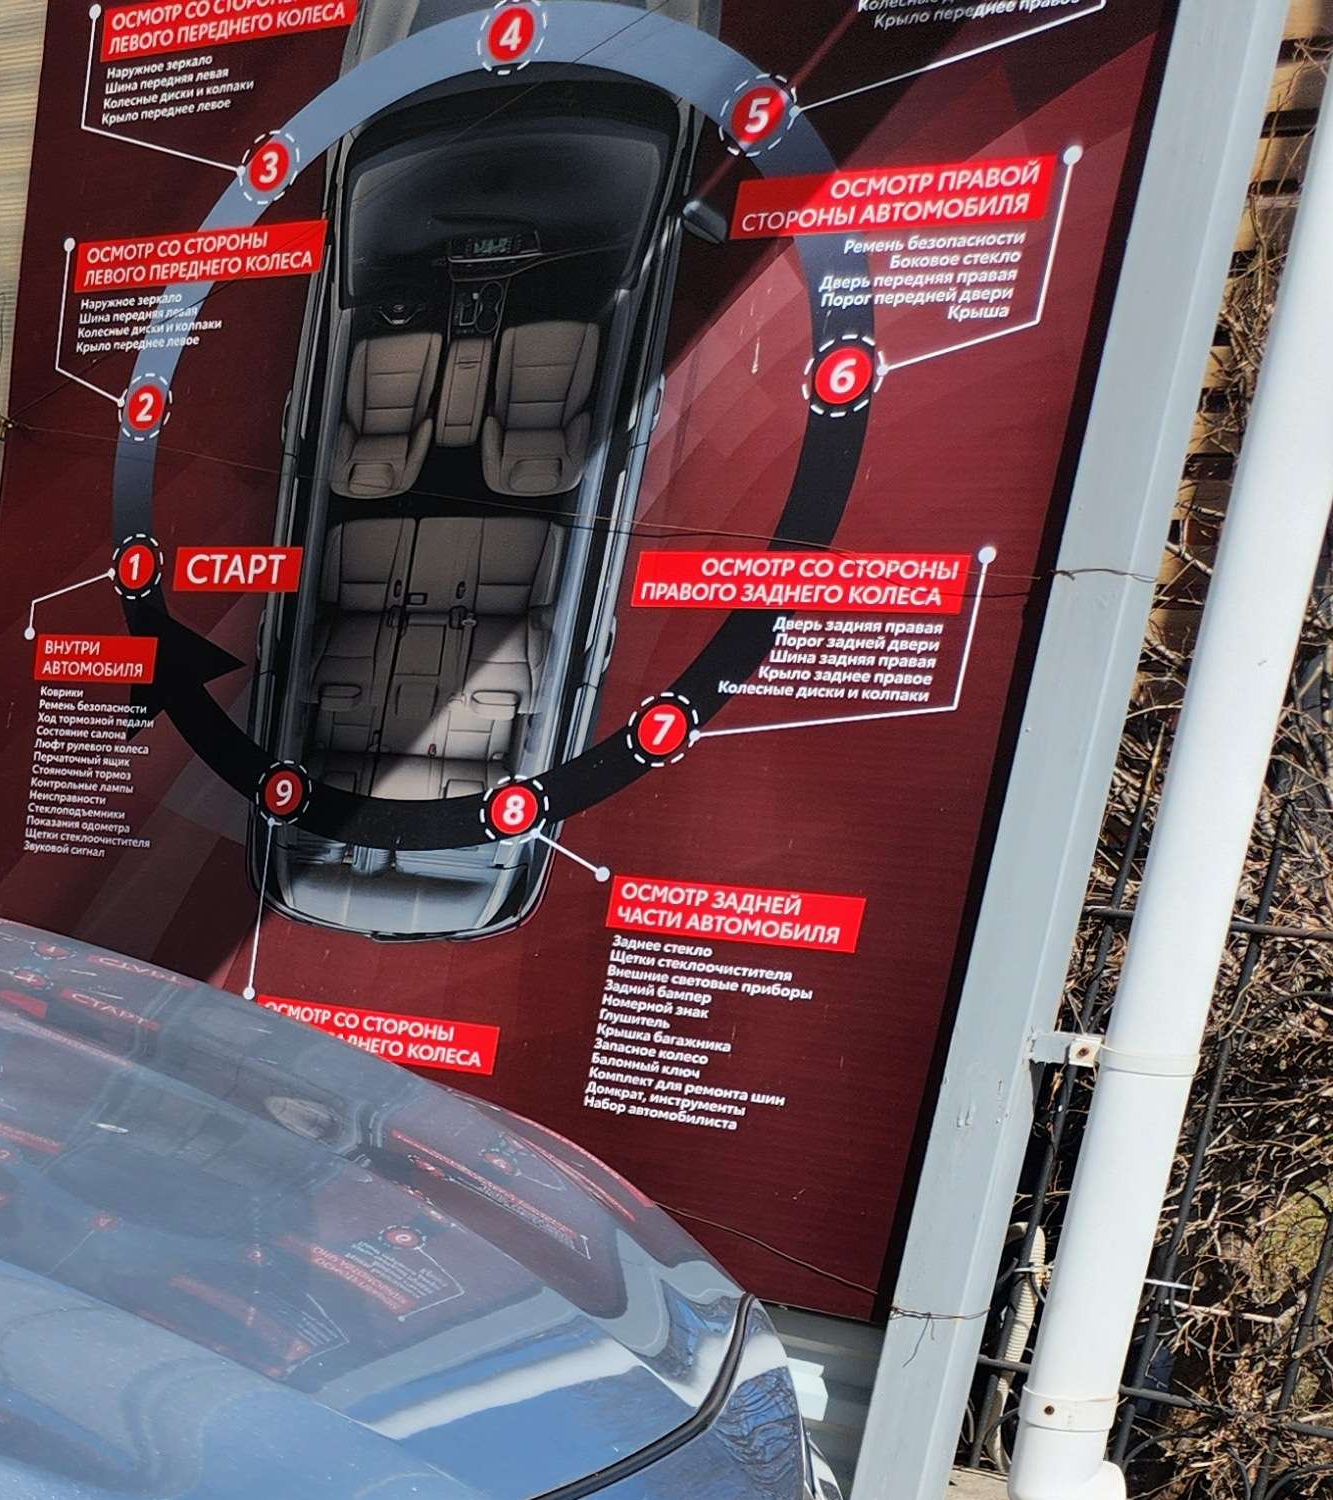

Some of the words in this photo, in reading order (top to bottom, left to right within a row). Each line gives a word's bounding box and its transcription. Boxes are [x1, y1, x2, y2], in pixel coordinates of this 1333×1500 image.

[108, 25, 174, 54] ЛЕВОГО
[176, 14, 273, 44] ПЕРЕДНЕГО
[276, 3, 346, 28] КОЛЕСА
[111, 4, 180, 31] ОСМОТР
[874, 10, 929, 31] Крыло
[933, 1, 1015, 23] переднее
[500, 19, 521, 52] 4
[105, 81, 138, 95] Шина
[140, 73, 193, 92] передняя
[196, 67, 229, 81] левая
[107, 62, 164, 81] Наружное
[166, 55, 213, 73] зеркало
[103, 94, 158, 110] Колесные
[159, 88, 194, 104] диски
[196, 87, 204, 97] и
[206, 80, 254, 96] колпаки
[102, 112, 138, 127] Крыло
[141, 105, 194, 121] переднее
[196, 98, 231, 111] левое
[745, 97, 770, 134] 5
[259, 152, 278, 183] 3
[831, 174, 933, 200] ОСМОТР
[937, 160, 1042, 190] ПРАВОЙ
[741, 205, 854, 232] СТОРОНЫ
[859, 193, 1030, 225] АВТОМОБИЛЯ
[87, 243, 153, 264] ОСМОТР
[157, 240, 180, 257] СО
[184, 232, 268, 255] СТОРОНЫ
[844, 239, 904, 255] Ремень
[907, 231, 1027, 251] безопасности
[84, 267, 145, 287] ЛЕВОГО
[149, 257, 242, 281] ПЕРЕДНЕГО
[246, 251, 312, 272] КОЛЕСА
[889, 253, 958, 270] Боковое
[963, 251, 1021, 266] стекло
[818, 275, 870, 293] Дверь
[873, 272, 952, 290] передняя
[956, 268, 1018, 286] правая
[81, 296, 135, 312] Наружное
[137, 293, 182, 308] зеркало
[820, 291, 870, 309] Порог
[873, 286, 957, 308] передней
[960, 286, 1013, 304] двери
[80, 312, 110, 325] Шина
[113, 310, 164, 325] передняя
[165, 306, 198, 318] левая
[947, 305, 1010, 320] Крыша
[78, 326, 129, 339] Колесные
[131, 323, 164, 337] диски
[175, 319, 222, 333] колпаки
[76, 341, 111, 354] Крыло
[113, 338, 164, 354] переднее
[166, 335, 200, 347] левое
[831, 359, 858, 393] 6
[136, 394, 153, 422] 2
[129, 553, 141, 581] 1
[186, 553, 286, 585] СТАРТ
[701, 557, 796, 578] ОСМОТР
[798, 558, 833, 579] СО
[838, 559, 959, 581] СТОРОНЫ
[640, 582, 736, 602] ПРАВОГО
[740, 584, 844, 606] ЗАДНЕГО
[848, 585, 942, 607] КОЛЕСА
[772, 617, 823, 635] Дверь
[825, 620, 882, 635] задняя
[885, 622, 944, 636] правая
[44, 640, 101, 657] ВНУТРИ
[774, 633, 824, 651] Порог
[826, 635, 886, 652] задней
[888, 638, 940, 654] двери
[41, 660, 144, 678] АВТОМОБИЛЯ
[769, 650, 817, 665] Шина
[818, 653, 876, 668] задняя
[878, 655, 936, 670] правая
[758, 665, 812, 683] Крыло
[813, 669, 872, 684] заднее
[874, 672, 933, 686] правое
[40, 686, 84, 700] Коврики
[718, 680, 794, 697] Колесные
[795, 684, 845, 699] диски
[848, 687, 859, 698] и
[861, 688, 929, 703] колпаки
[39, 700, 76, 712] Ремень
[77, 701, 147, 715] безопасности
[36, 726, 89, 739] Состояние
[90, 729, 127, 740] салона
[37, 713, 58, 726] Ход
[59, 714, 114, 729] тормозной
[116, 717, 154, 729] педали
[650, 714, 675, 745] 7
[34, 738, 66, 753] Люфт
[66, 742, 113, 755] рулевого
[114, 743, 149, 755] колеса
[32, 764, 94, 779] Стояночный
[94, 768, 132, 781] тормоз
[33, 752, 101, 767] Перчаточный
[102, 756, 131, 768] ящик
[29, 790, 107, 806] Неисправности
[30, 777, 99, 793] Контрольные
[100, 782, 134, 794] лампы
[275, 780, 293, 806] 9
[27, 803, 126, 820] Стеклоподъемники
[502, 794, 526, 826] 8
[26, 815, 81, 829] Показания
[82, 819, 131, 834] одометра
[23, 840, 69, 855] Звуковой
[70, 845, 105, 858] сигнал
[25, 828, 59, 841] Щетки
[60, 832, 151, 849] стеклоочистителя
[620, 881, 710, 906] ОСМОТР
[711, 890, 802, 917] ЗАДНЕЙ
[617, 905, 683, 927] ЧАСТИ
[685, 910, 841, 944] АВТОМОБИЛЯ
[612, 934, 662, 953] Заднее
[663, 942, 713, 958] стекло
[609, 949, 656, 968] Щетки
[657, 956, 793, 983] стеклоочистителя
[604, 978, 655, 999] Задний
[656, 986, 713, 1007] бампер
[607, 964, 670, 983] Внешние
[670, 972, 739, 992] световые
[740, 981, 813, 1001] приборы
[599, 1008, 671, 1030] Глушитель
[601, 993, 673, 1016] Номерной
[674, 1004, 710, 1019] знак
[334, 1011, 359, 1030] СО
[362, 1017, 454, 1042] СТОРОНЫ
[596, 1023, 652, 1044] Крышка
[653, 1031, 731, 1053] багажника
[329, 1033, 404, 1056] ДНЕГО
[407, 1042, 482, 1068] КОЛЕСА
[593, 1037, 657, 1058] Запасное
[658, 1048, 709, 1066] колесо
[591, 1051, 660, 1074] Балонный
[661, 1063, 701, 1080] ключ
[585, 1081, 648, 1104] Домкрат,
[649, 1092, 746, 1118] инструменты
[588, 1066, 654, 1089] Комплект
[655, 1076, 683, 1092] для
[684, 1081, 749, 1102] ремонта
[751, 1092, 786, 1107] шин
[583, 1095, 626, 1116] Набор
[627, 1104, 738, 1131] автомобилиста
